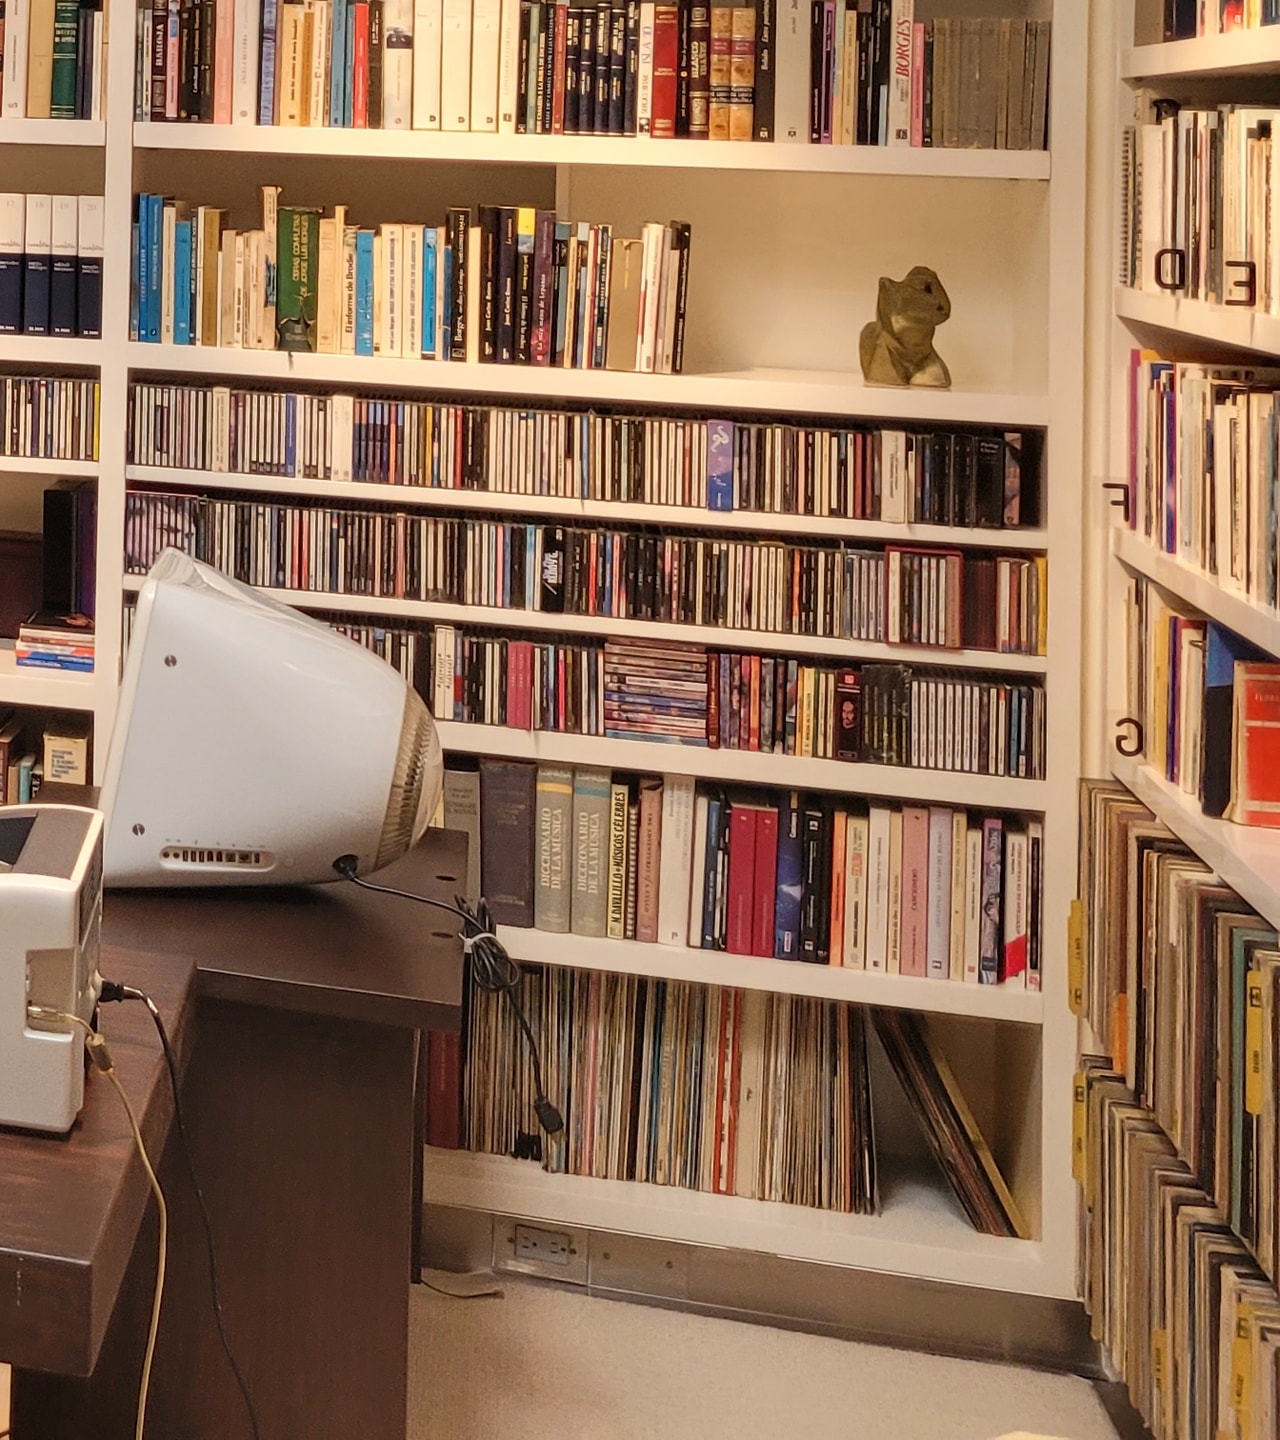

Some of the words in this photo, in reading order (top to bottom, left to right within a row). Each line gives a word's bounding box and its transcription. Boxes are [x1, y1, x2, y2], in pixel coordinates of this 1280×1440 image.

[155, 24, 164, 66] BAROJA
[895, 18, 910, 77] BORGES
[301, 215, 309, 243] BORGES
[345, 253, 354, 280] Brodie
[345, 293, 353, 325] informe
[613, 792, 625, 832] CÉLEBRES
[541, 808, 551, 886] DICCIONARIO
[550, 808, 562, 855] MÚSICA
[588, 813, 600, 860] MÚSICA
[551, 857, 561, 873] LA
[578, 812, 588, 891] DICCIONARIO
[613, 834, 624, 867] MÚSICOS
[551, 875, 561, 889] DE
[588, 861, 599, 876] LA
[588, 879, 599, 893] DE
